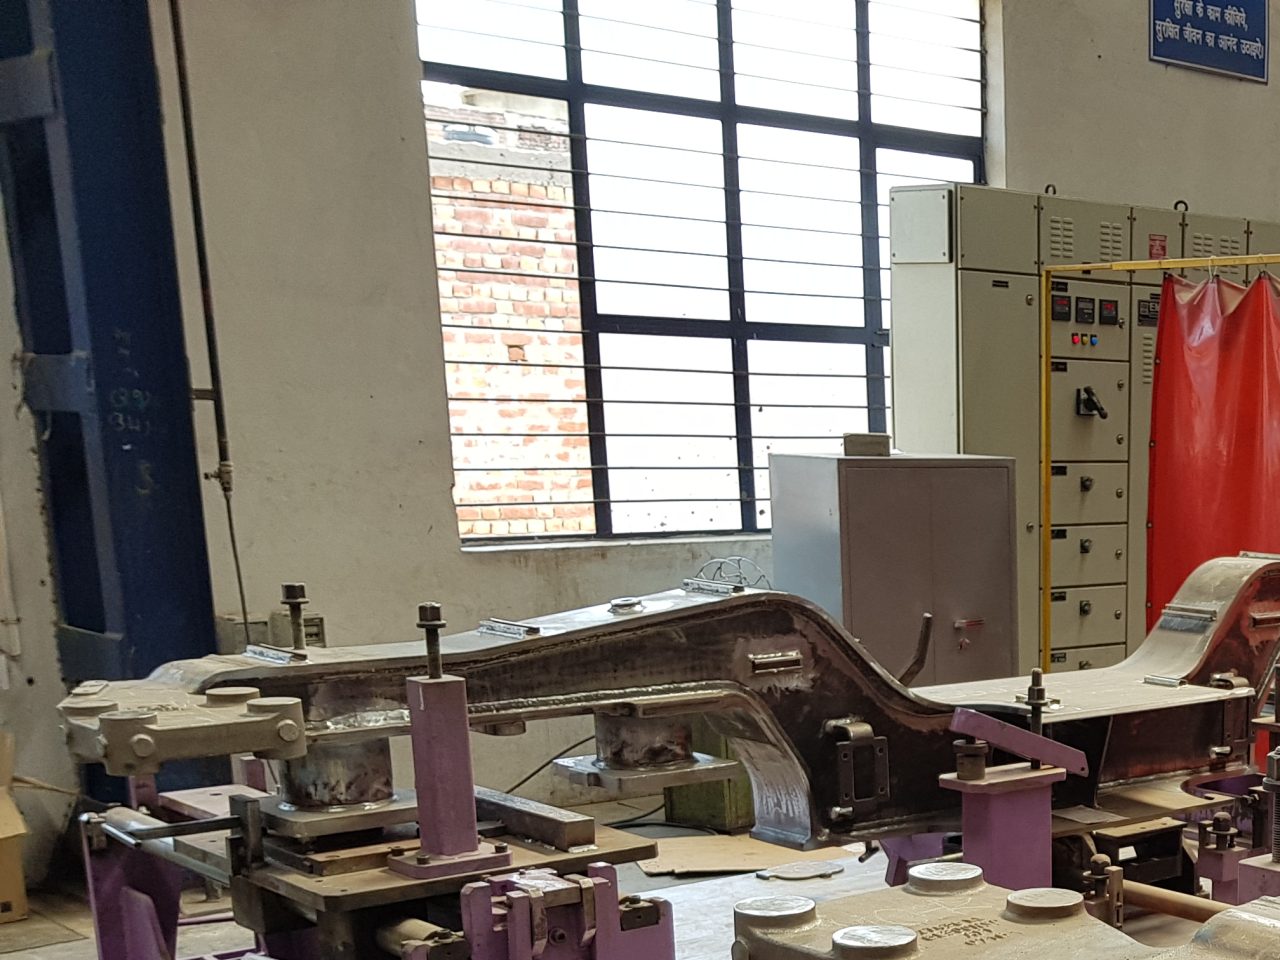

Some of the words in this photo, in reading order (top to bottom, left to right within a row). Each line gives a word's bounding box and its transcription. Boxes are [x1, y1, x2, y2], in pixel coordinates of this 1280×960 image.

[1206, 5, 1221, 23] काम
[1155, 18, 1180, 41] सुरक्षित
[1183, 22, 1203, 45] जीवन
[1205, 31, 1215, 48] का
[1218, 33, 1238, 53] आनंद
